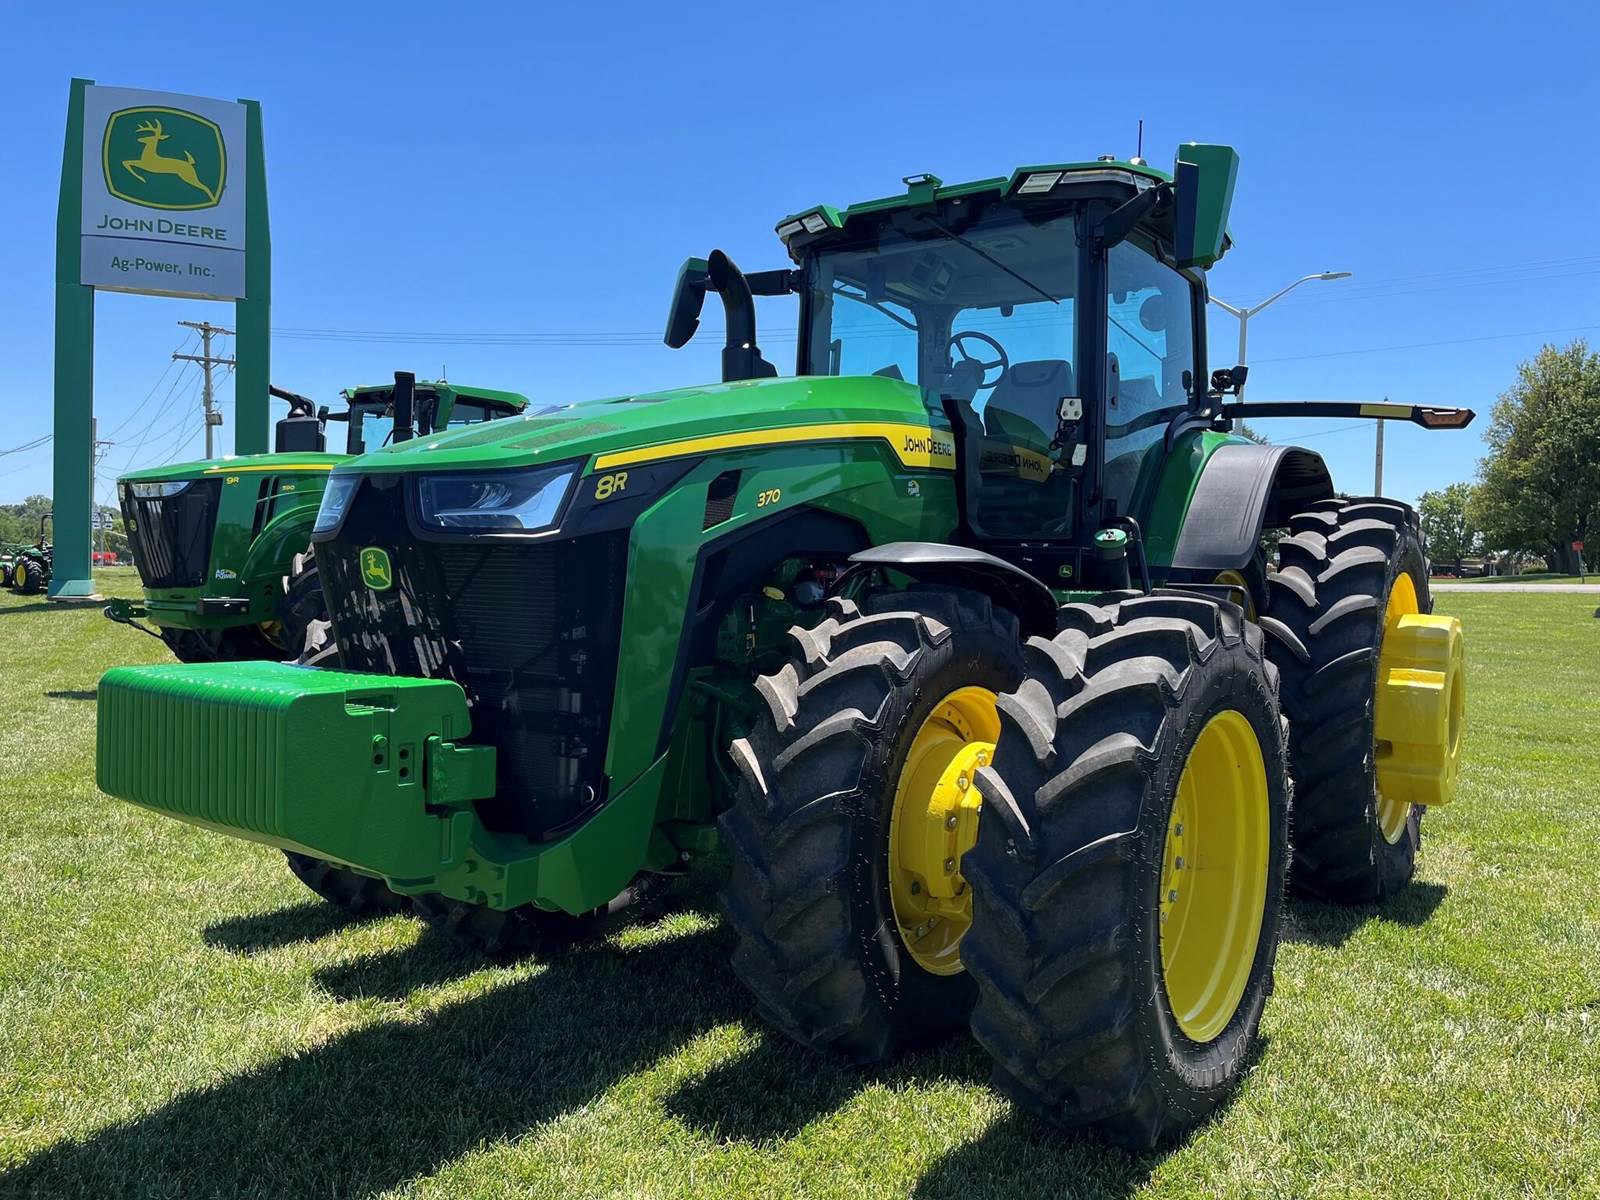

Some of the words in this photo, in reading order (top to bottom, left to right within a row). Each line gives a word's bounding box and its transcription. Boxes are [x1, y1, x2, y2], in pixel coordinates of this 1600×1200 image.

[97, 214, 153, 232] JOHN
[157, 219, 227, 241] DEERE
[111, 256, 182, 275] Ag-Power,
[188, 263, 216, 278] Inc.
[903, 434, 926, 453] JOHN
[926, 438, 952, 456] DEERE
[226, 477, 239, 485] 9R
[594, 472, 628, 500] 8R
[757, 488, 781, 508] 370
